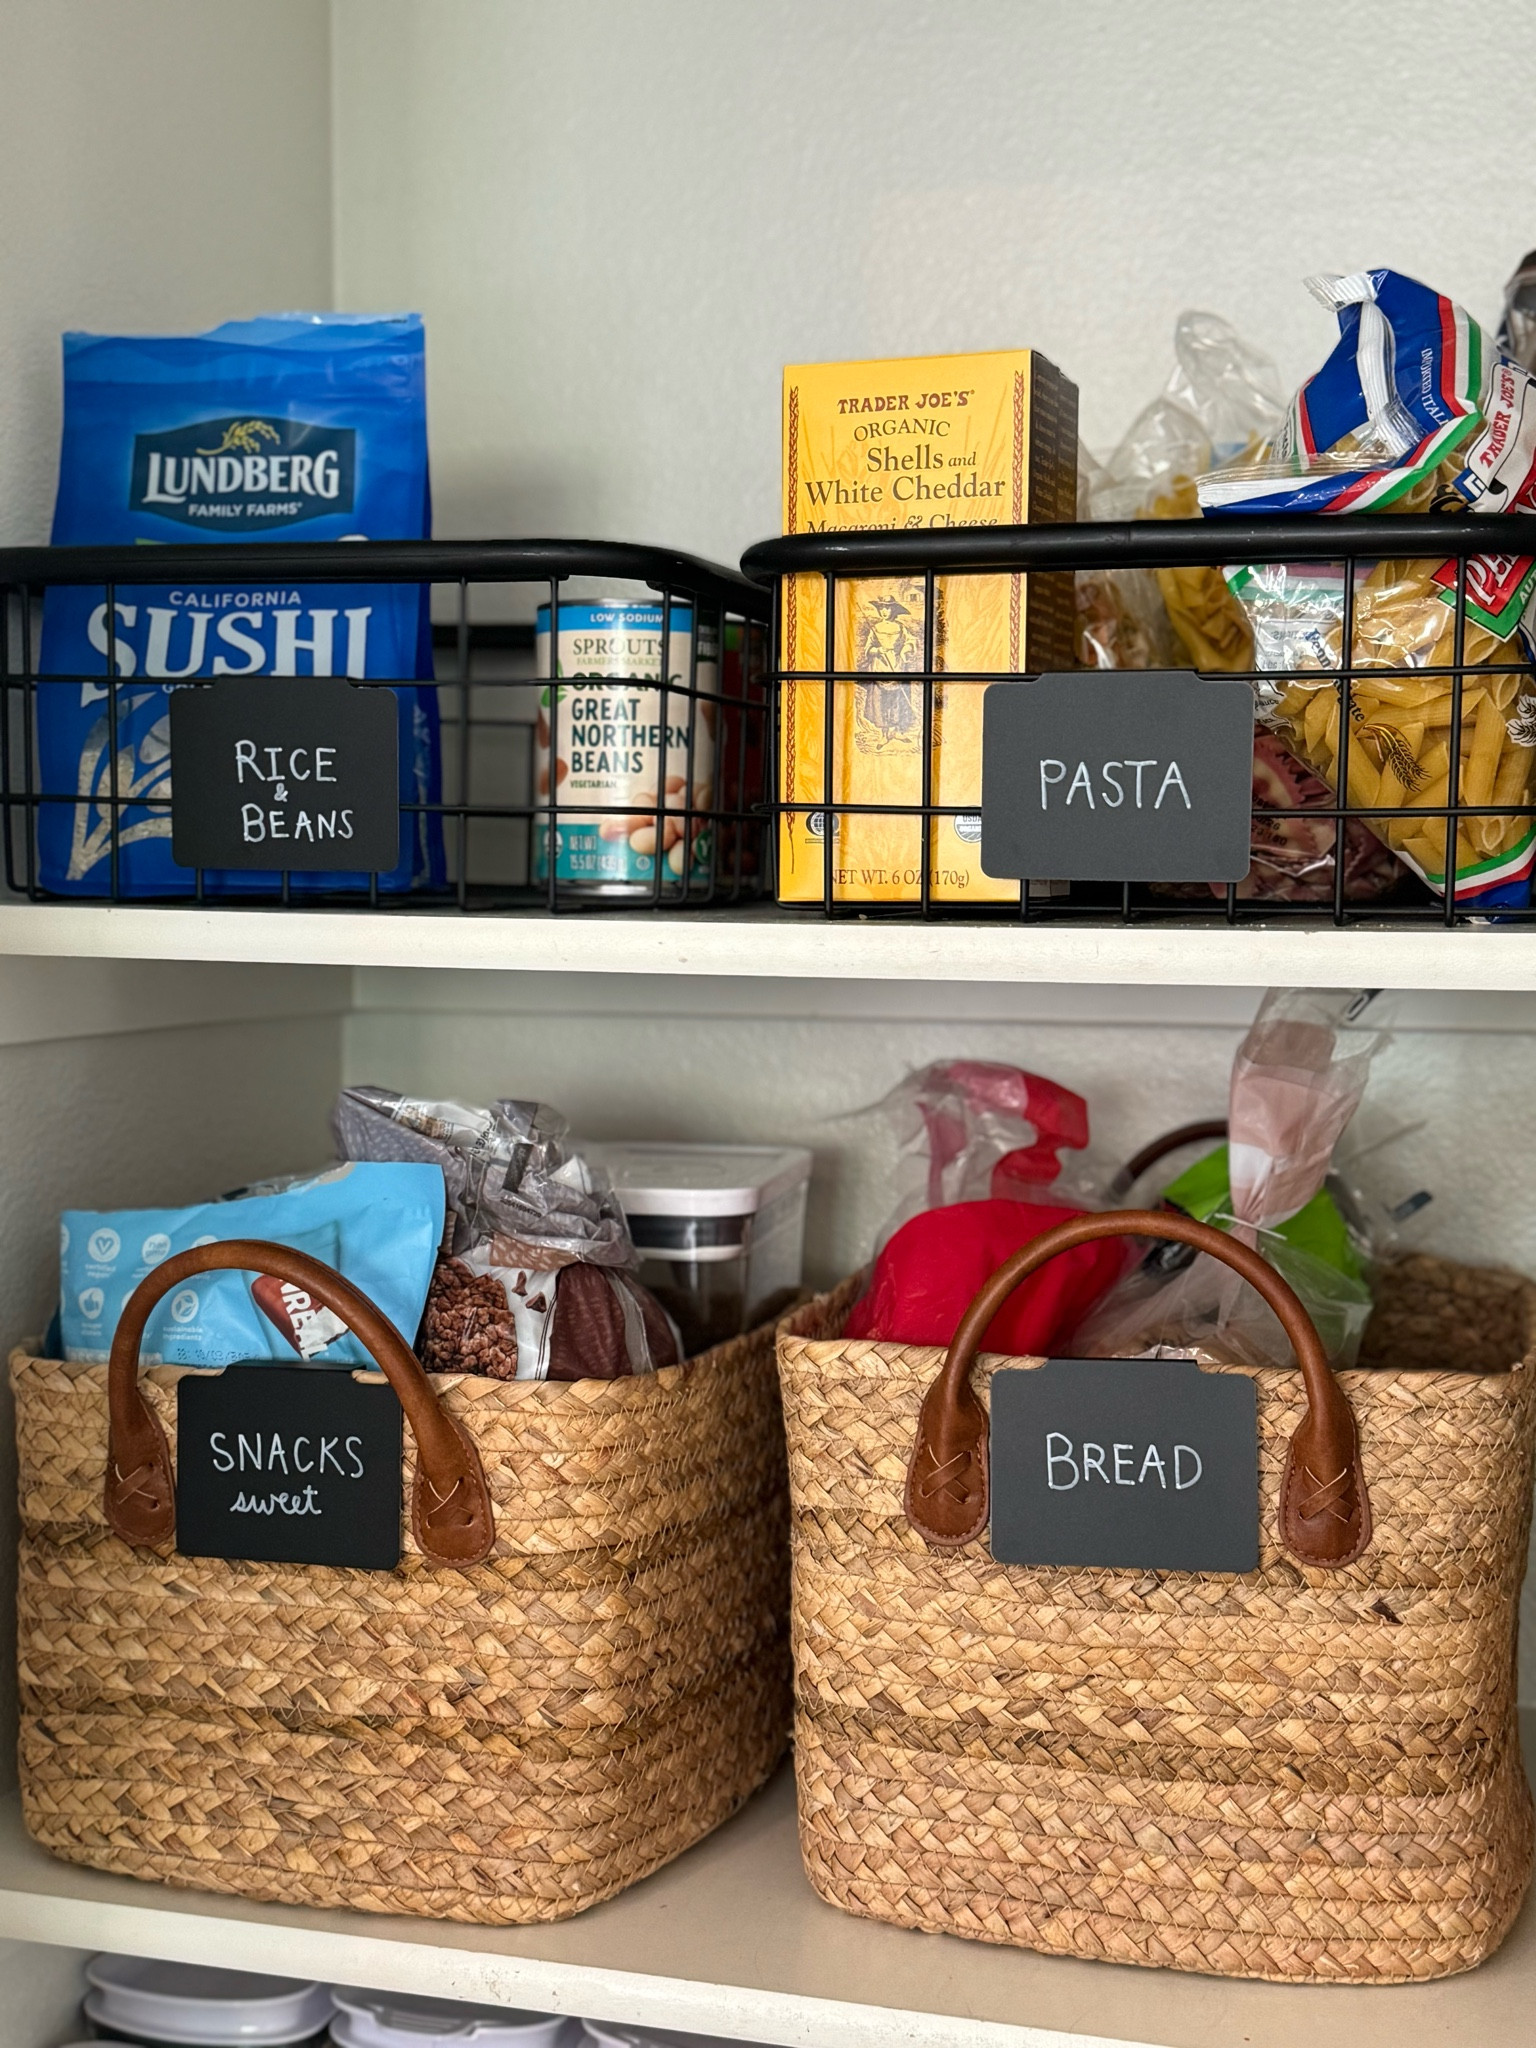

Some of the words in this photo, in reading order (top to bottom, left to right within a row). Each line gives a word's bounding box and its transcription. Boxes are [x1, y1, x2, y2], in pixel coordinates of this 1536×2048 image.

[837, 394, 910, 414] TRADER
[853, 418, 951, 442] ORGANIC
[1479, 410, 1513, 469] TRADER
[866, 443, 944, 473] Shells
[947, 451, 977, 468] and
[141, 449, 340, 504] LUNDBERG
[804, 479, 884, 506] White
[892, 472, 1007, 501] Cheddar
[187, 503, 243, 518] FAMILY
[168, 590, 302, 608] CALIFORNIA
[590, 613, 616, 623] LOW
[618, 613, 664, 624] SODIUM
[80, 602, 372, 709] SUSHI
[571, 698, 641, 721] GREAT
[571, 724, 690, 748] NORTHERN
[234, 739, 337, 783] RICE
[571, 751, 644, 773] BEANS
[273, 782, 289, 802] &
[1040, 759, 1192, 810] PASTA
[241, 803, 354, 842] BEANS
[832, 869, 857, 885] NET
[861, 869, 888, 885] WT.
[891, 870, 900, 885] 6
[928, 870, 970, 889] (170g)
[209, 1432, 364, 1479] SNACKS
[1046, 1431, 1203, 1491] BREAD
[229, 1484, 323, 1516] sweet
